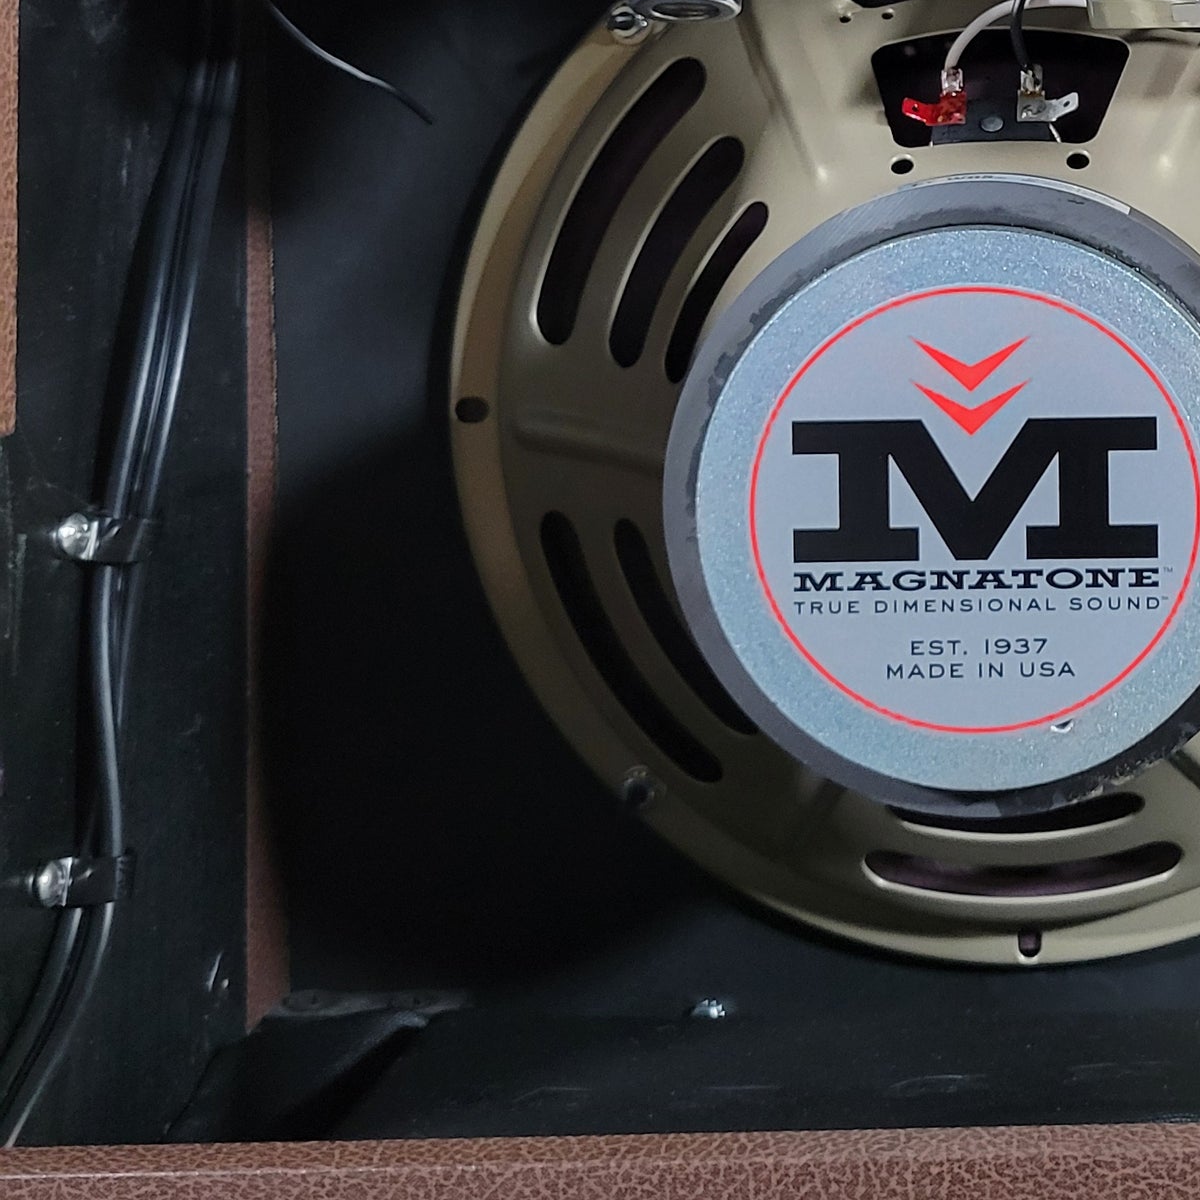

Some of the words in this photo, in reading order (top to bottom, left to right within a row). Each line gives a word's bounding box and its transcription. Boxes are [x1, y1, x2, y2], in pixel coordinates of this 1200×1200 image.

[793, 567, 1160, 592] MAGNATONE
[793, 600, 861, 615] TRUE
[874, 597, 1056, 614] DIMENSIONAL
[1069, 596, 1161, 611] SOUND
[910, 640, 968, 656] EST.
[984, 638, 1048, 655] 1937
[886, 663, 964, 679] MADE
[979, 662, 1004, 678] IN
[1019, 661, 1076, 678] USA
